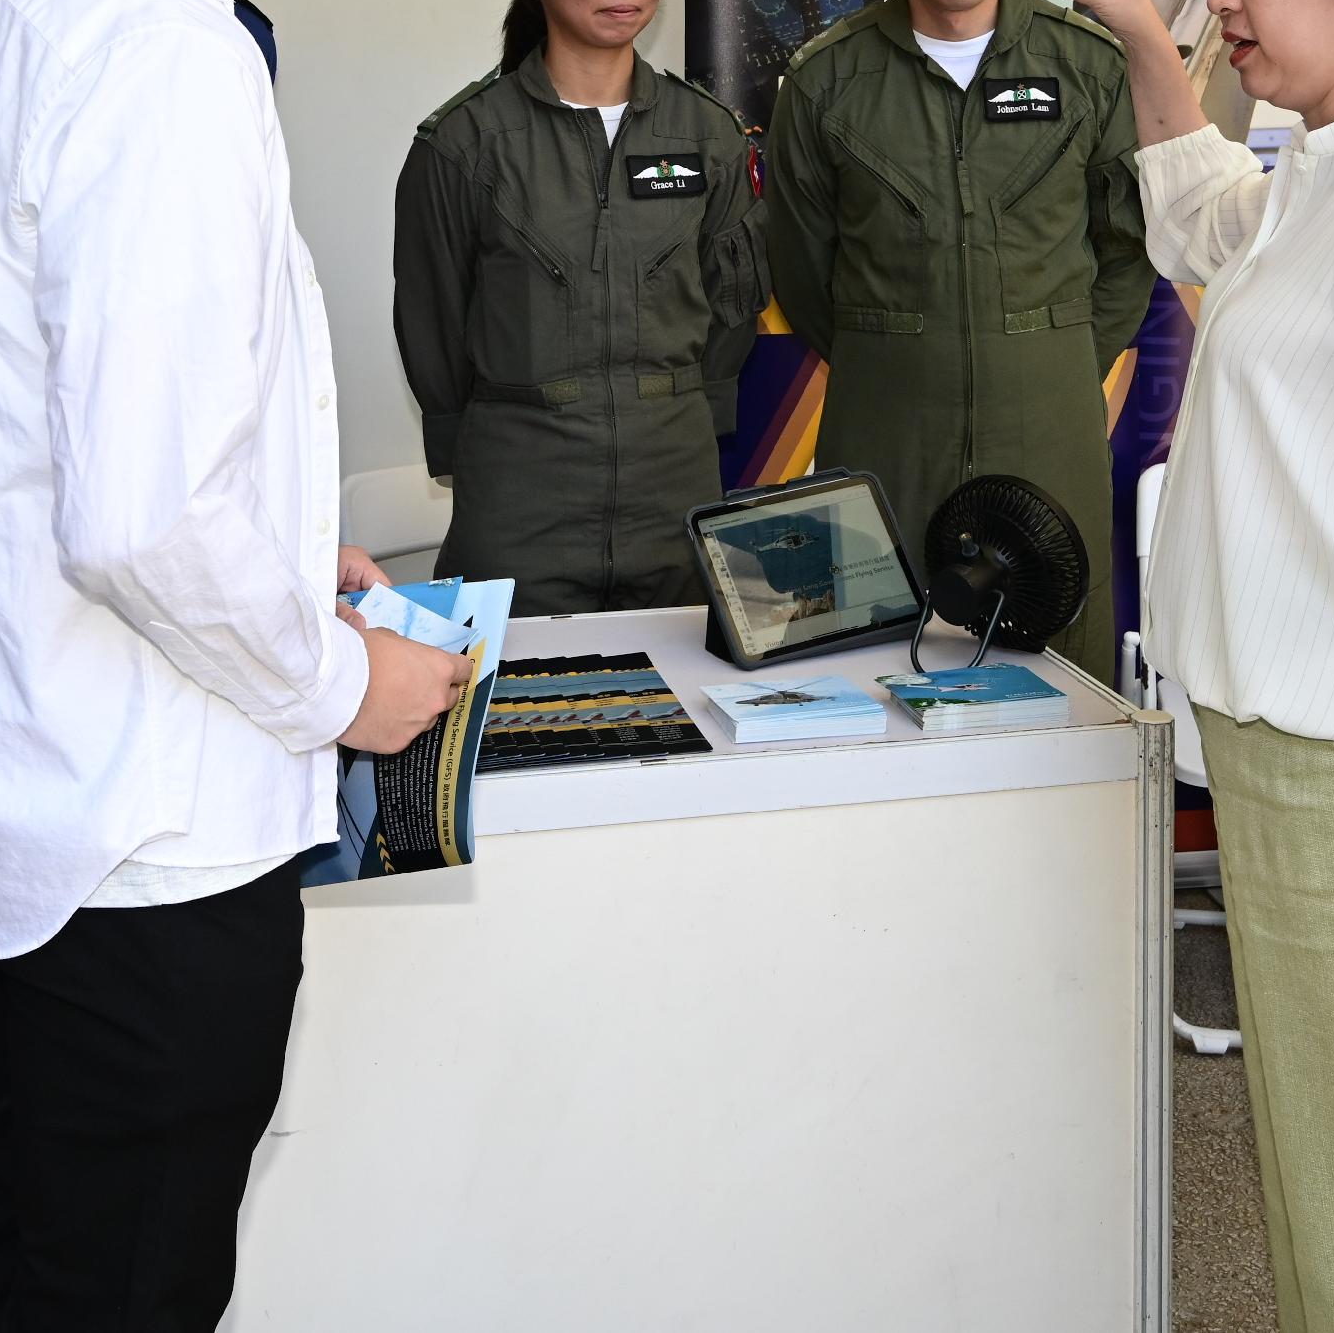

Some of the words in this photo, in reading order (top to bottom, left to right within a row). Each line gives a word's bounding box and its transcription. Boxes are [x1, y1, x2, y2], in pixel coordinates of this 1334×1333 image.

[997, 105, 1028, 114] Johnson
[1031, 102, 1050, 112] Lam
[650, 181, 674, 190] Grace
[676, 179, 686, 188] Li
[452, 702, 465, 727] Flying
[448, 727, 460, 755] Service
[444, 756, 454, 784] (GFS)
